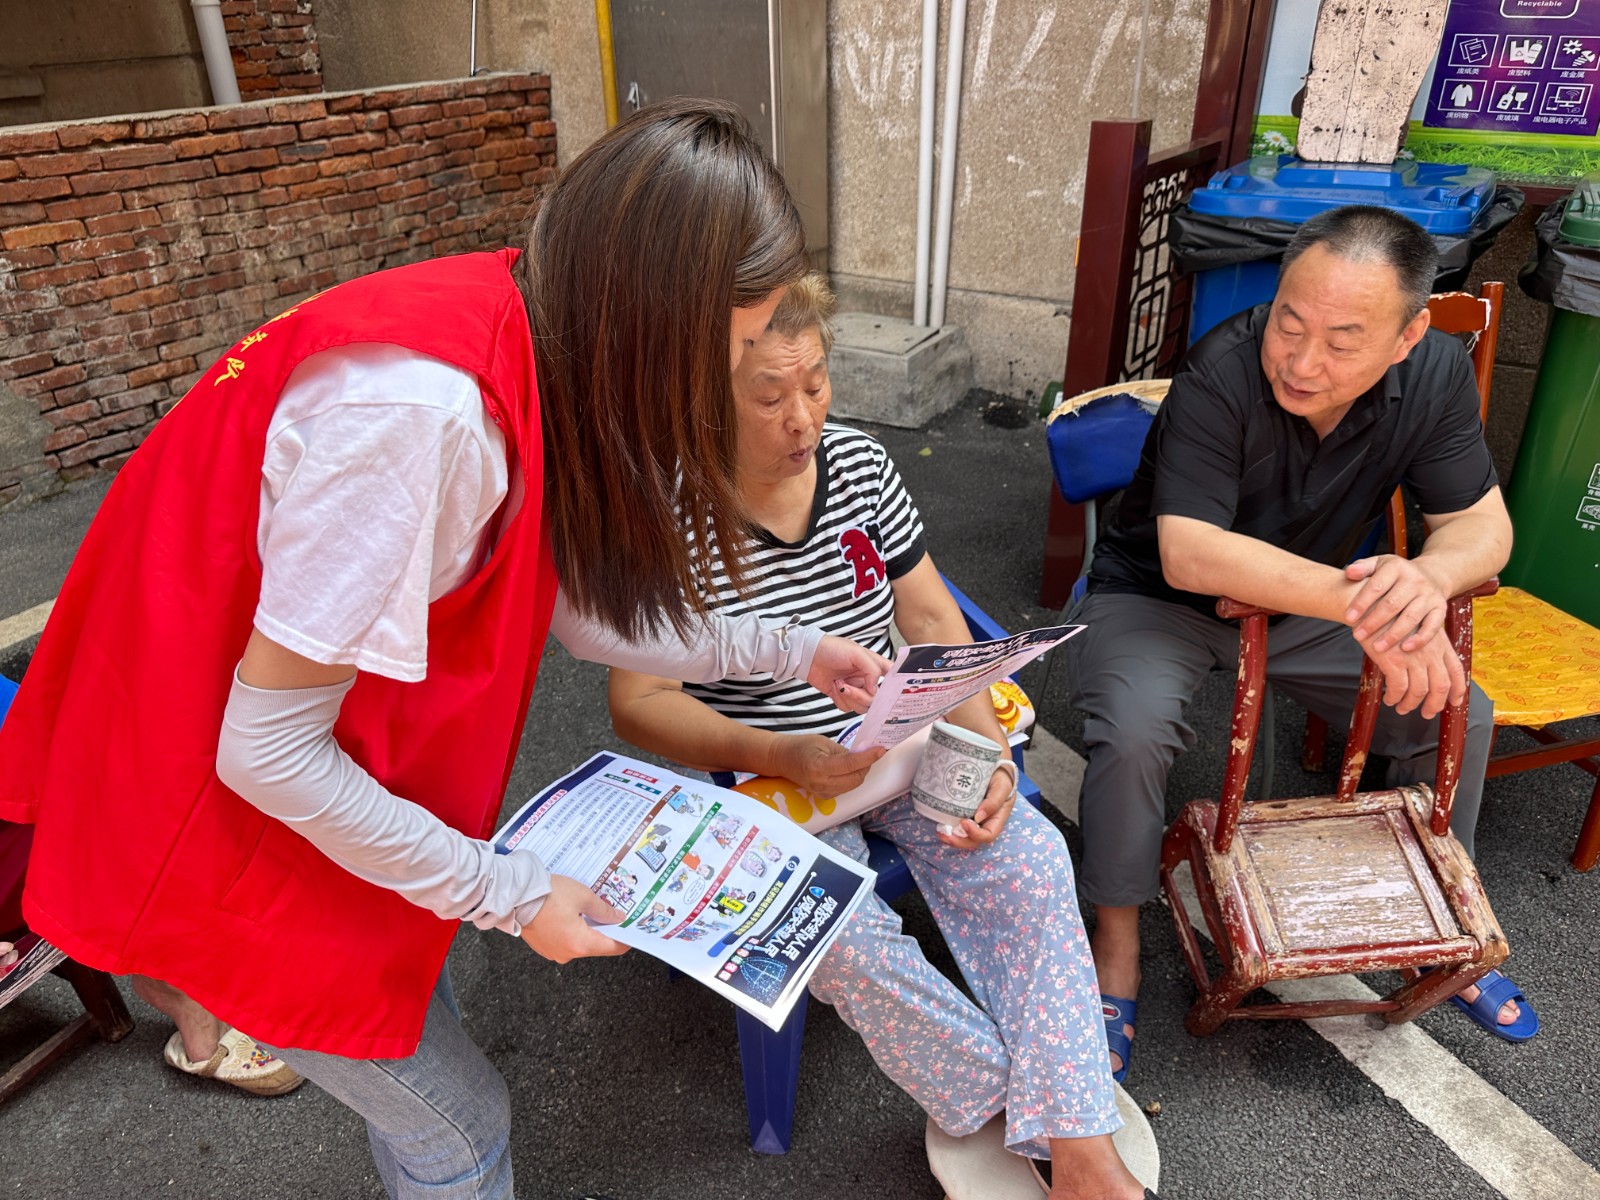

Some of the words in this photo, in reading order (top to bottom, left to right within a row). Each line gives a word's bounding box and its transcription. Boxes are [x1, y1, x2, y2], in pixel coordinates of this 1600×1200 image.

[1456, 68, 1479, 76] 废纸类
[1507, 69, 1531, 77] 废塑料
[1560, 71, 1585, 79] 废金属
[1446, 112, 1469, 120] 废织物
[1496, 114, 1519, 122] 废玻璃
[1532, 115, 1587, 125] 废电器电子产品
[956, 774, 972, 788] 茶
[781, 896, 838, 961] 网络安全为人民
